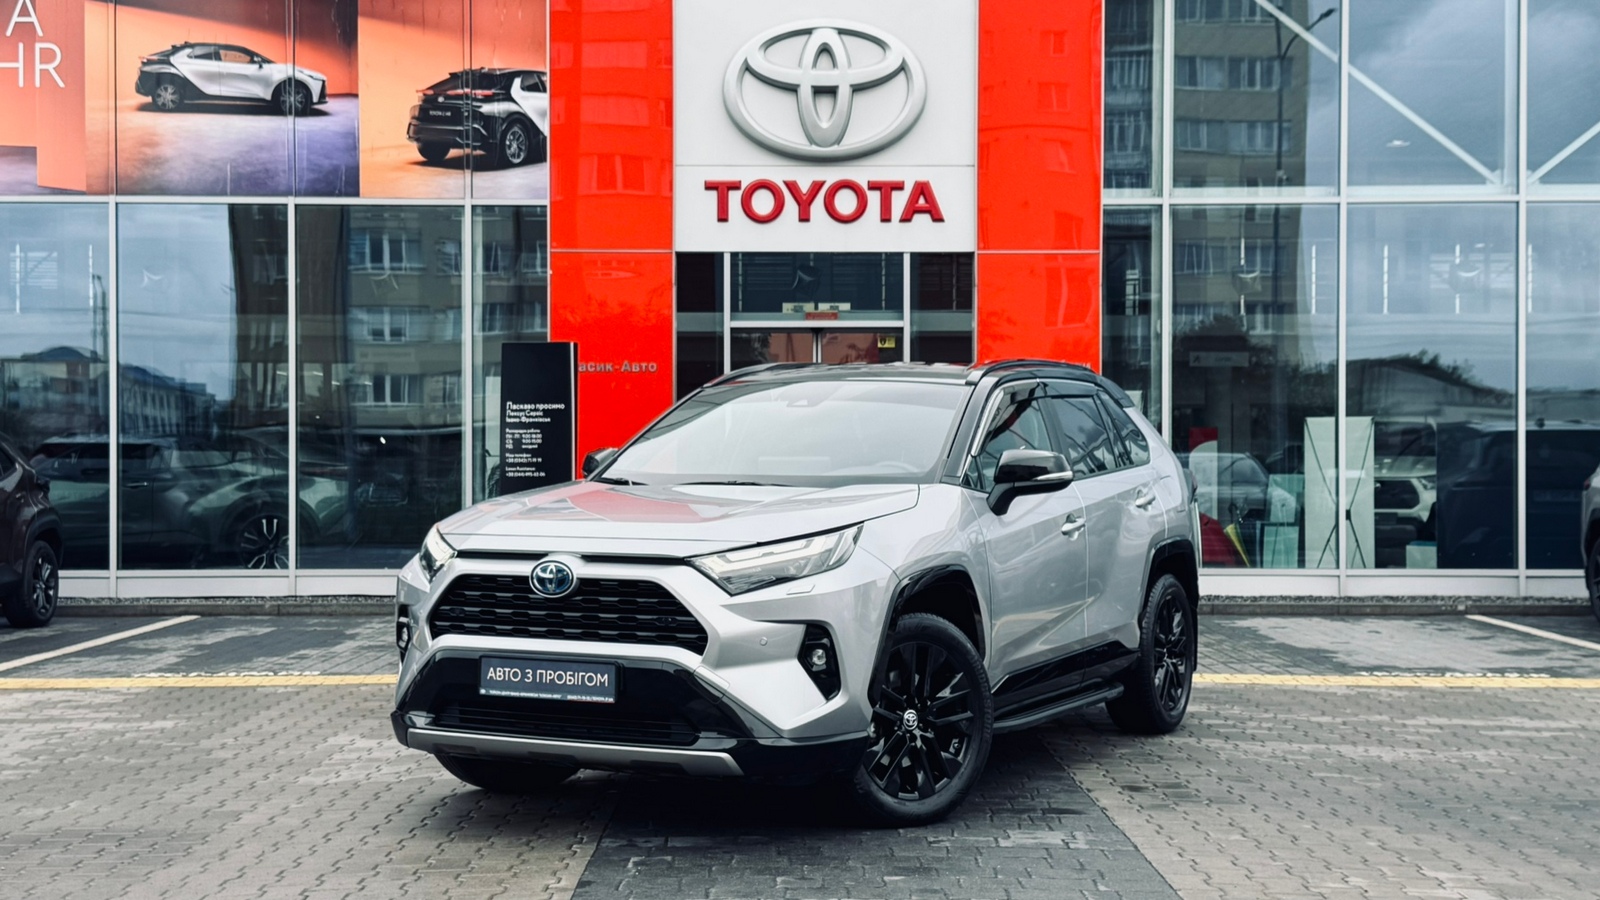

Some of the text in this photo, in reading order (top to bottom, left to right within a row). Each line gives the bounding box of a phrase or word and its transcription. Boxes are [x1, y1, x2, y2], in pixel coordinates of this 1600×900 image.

[704, 179, 945, 224] TOYOTA
[487, 667, 608, 687] АВТО З ПРОБІГОМ
